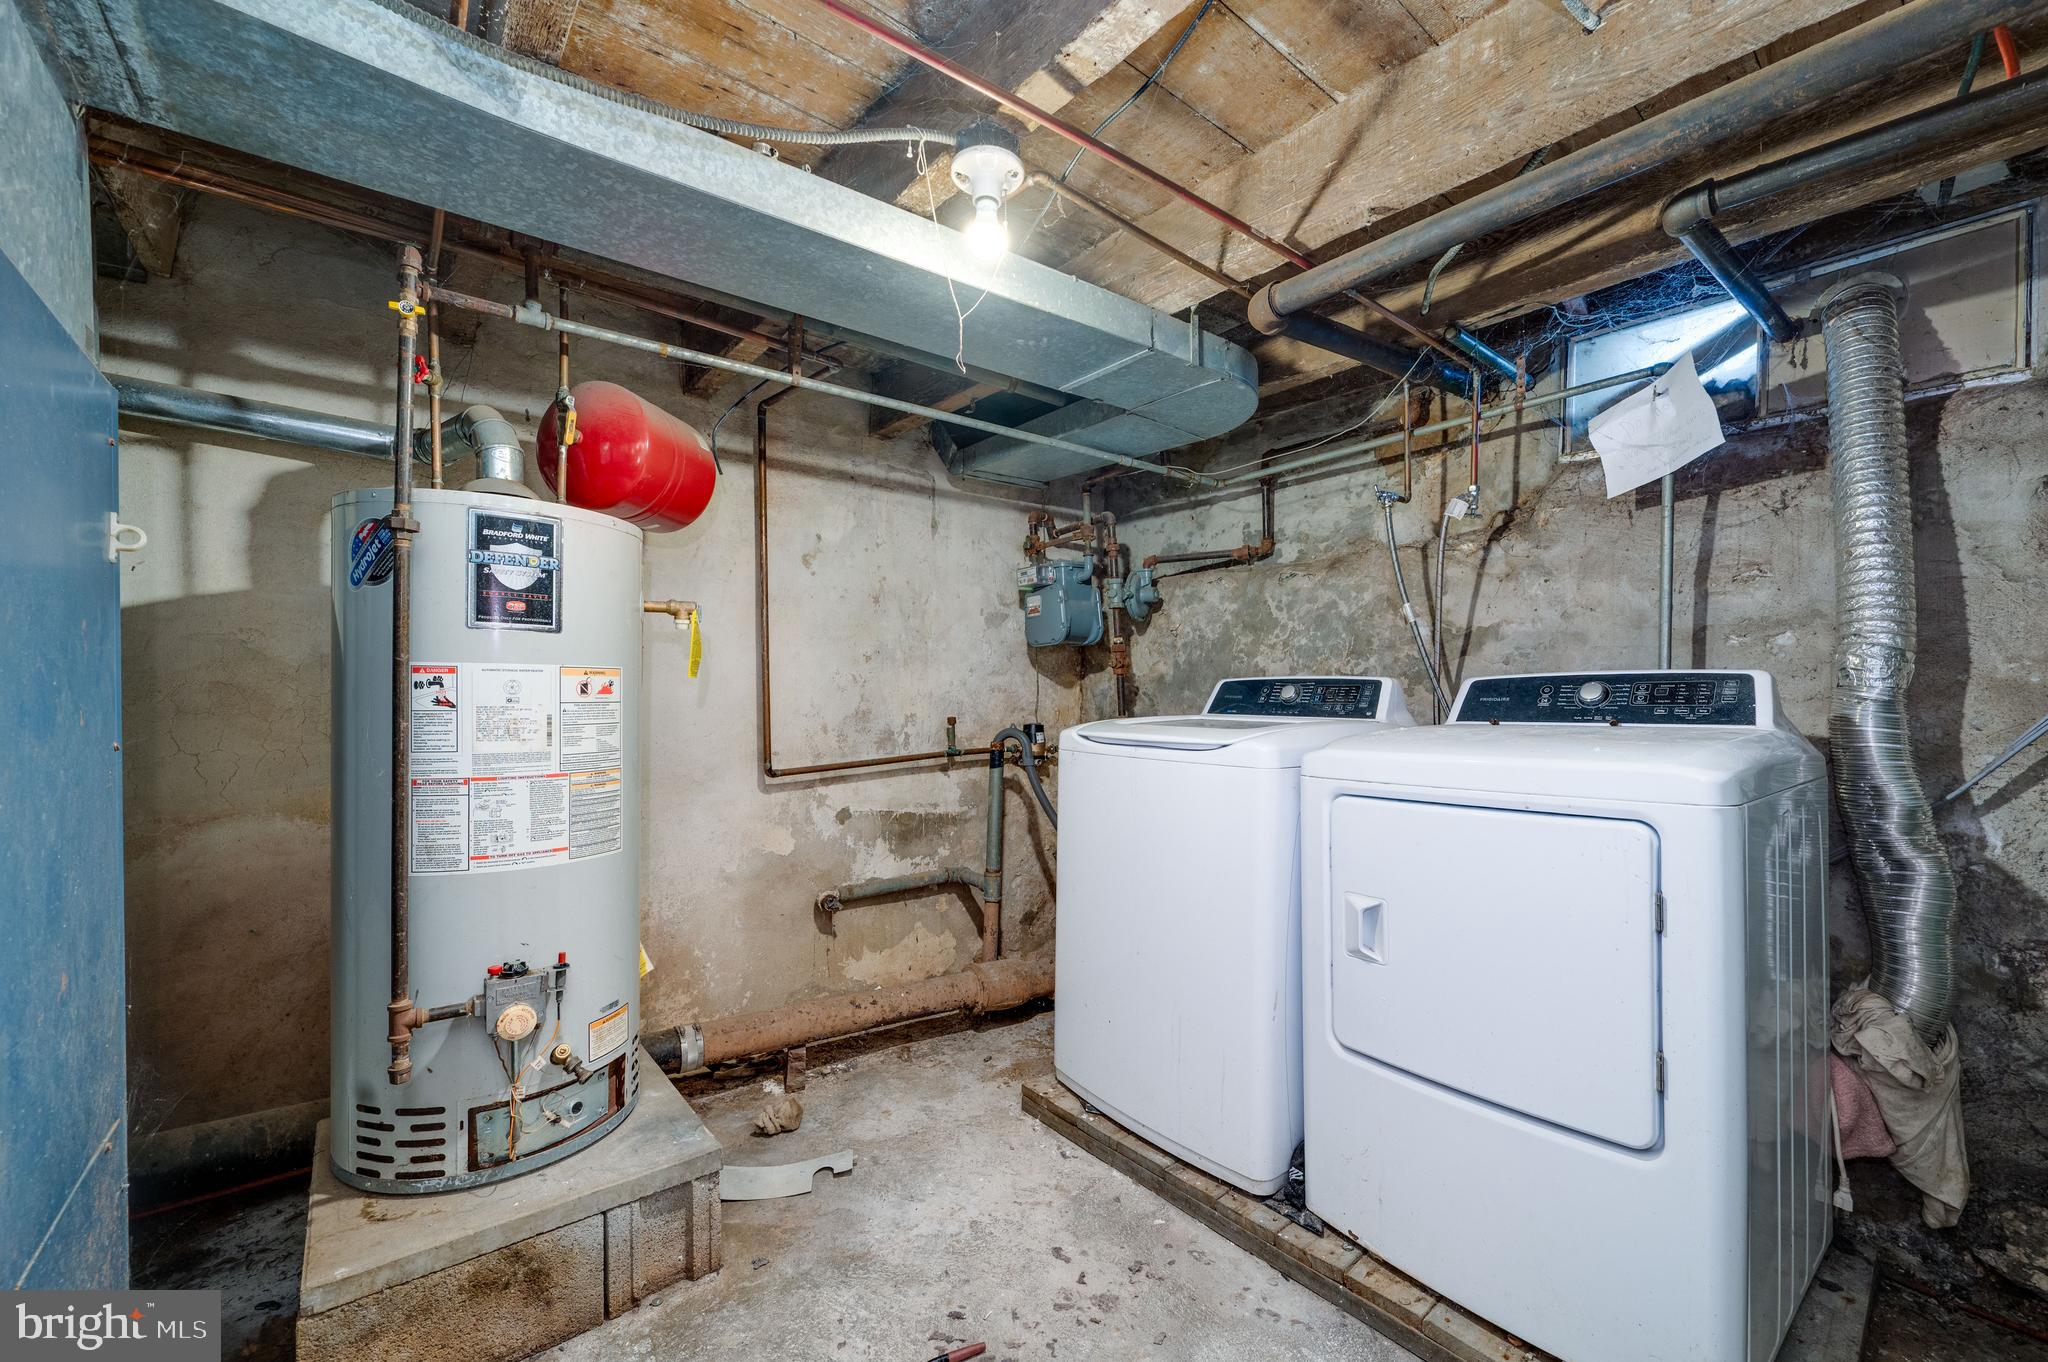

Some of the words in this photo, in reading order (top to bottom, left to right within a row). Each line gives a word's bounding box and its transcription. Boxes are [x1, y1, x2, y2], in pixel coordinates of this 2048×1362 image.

[482, 528, 524, 539] BRADFORD
[525, 533, 549, 542] WHITE
[352, 538, 382, 582] Hydrojet
[469, 549, 561, 571] DEFENDER
